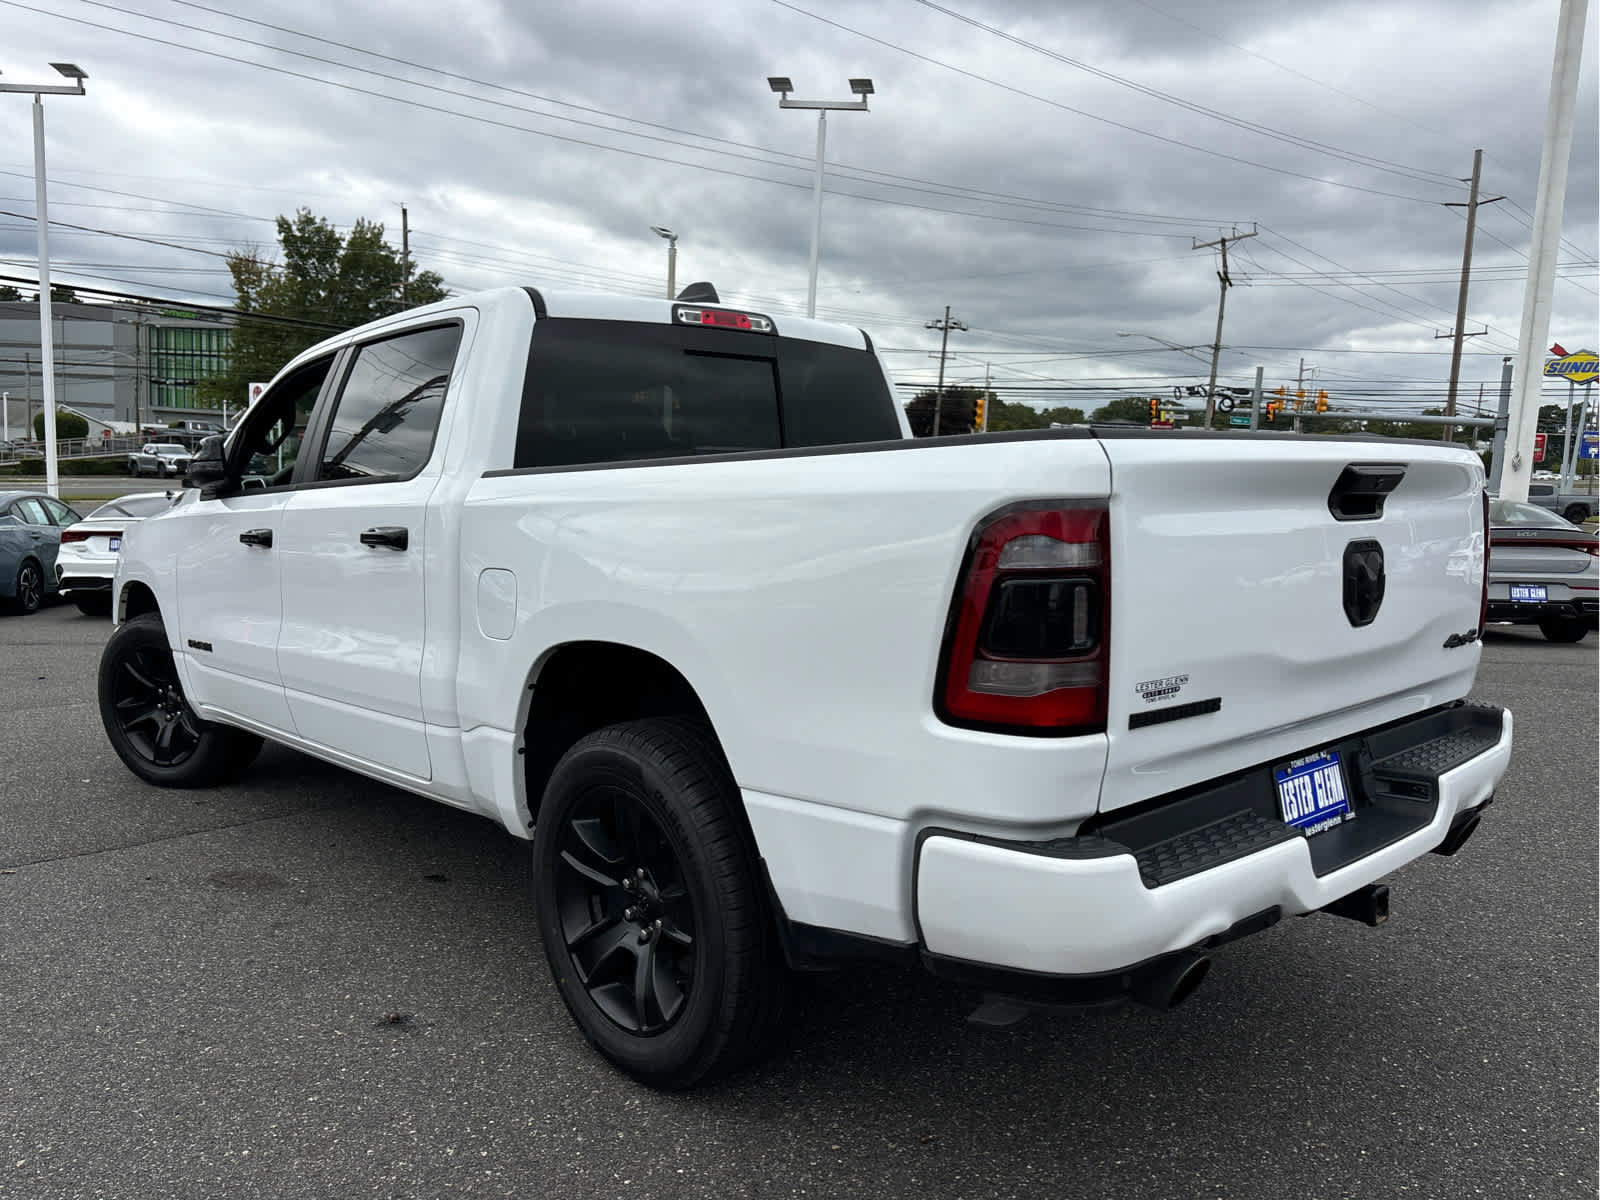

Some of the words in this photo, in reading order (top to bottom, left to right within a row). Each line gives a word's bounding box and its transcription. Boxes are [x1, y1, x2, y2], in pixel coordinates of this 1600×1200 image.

[1511, 587, 1529, 598] LESTER
[1530, 588, 1546, 598] GLENN
[1135, 680, 1163, 692] LESTER
[1165, 676, 1189, 687] GLENN
[1278, 776, 1314, 823] LESTER
[1314, 765, 1344, 808] GLENN
